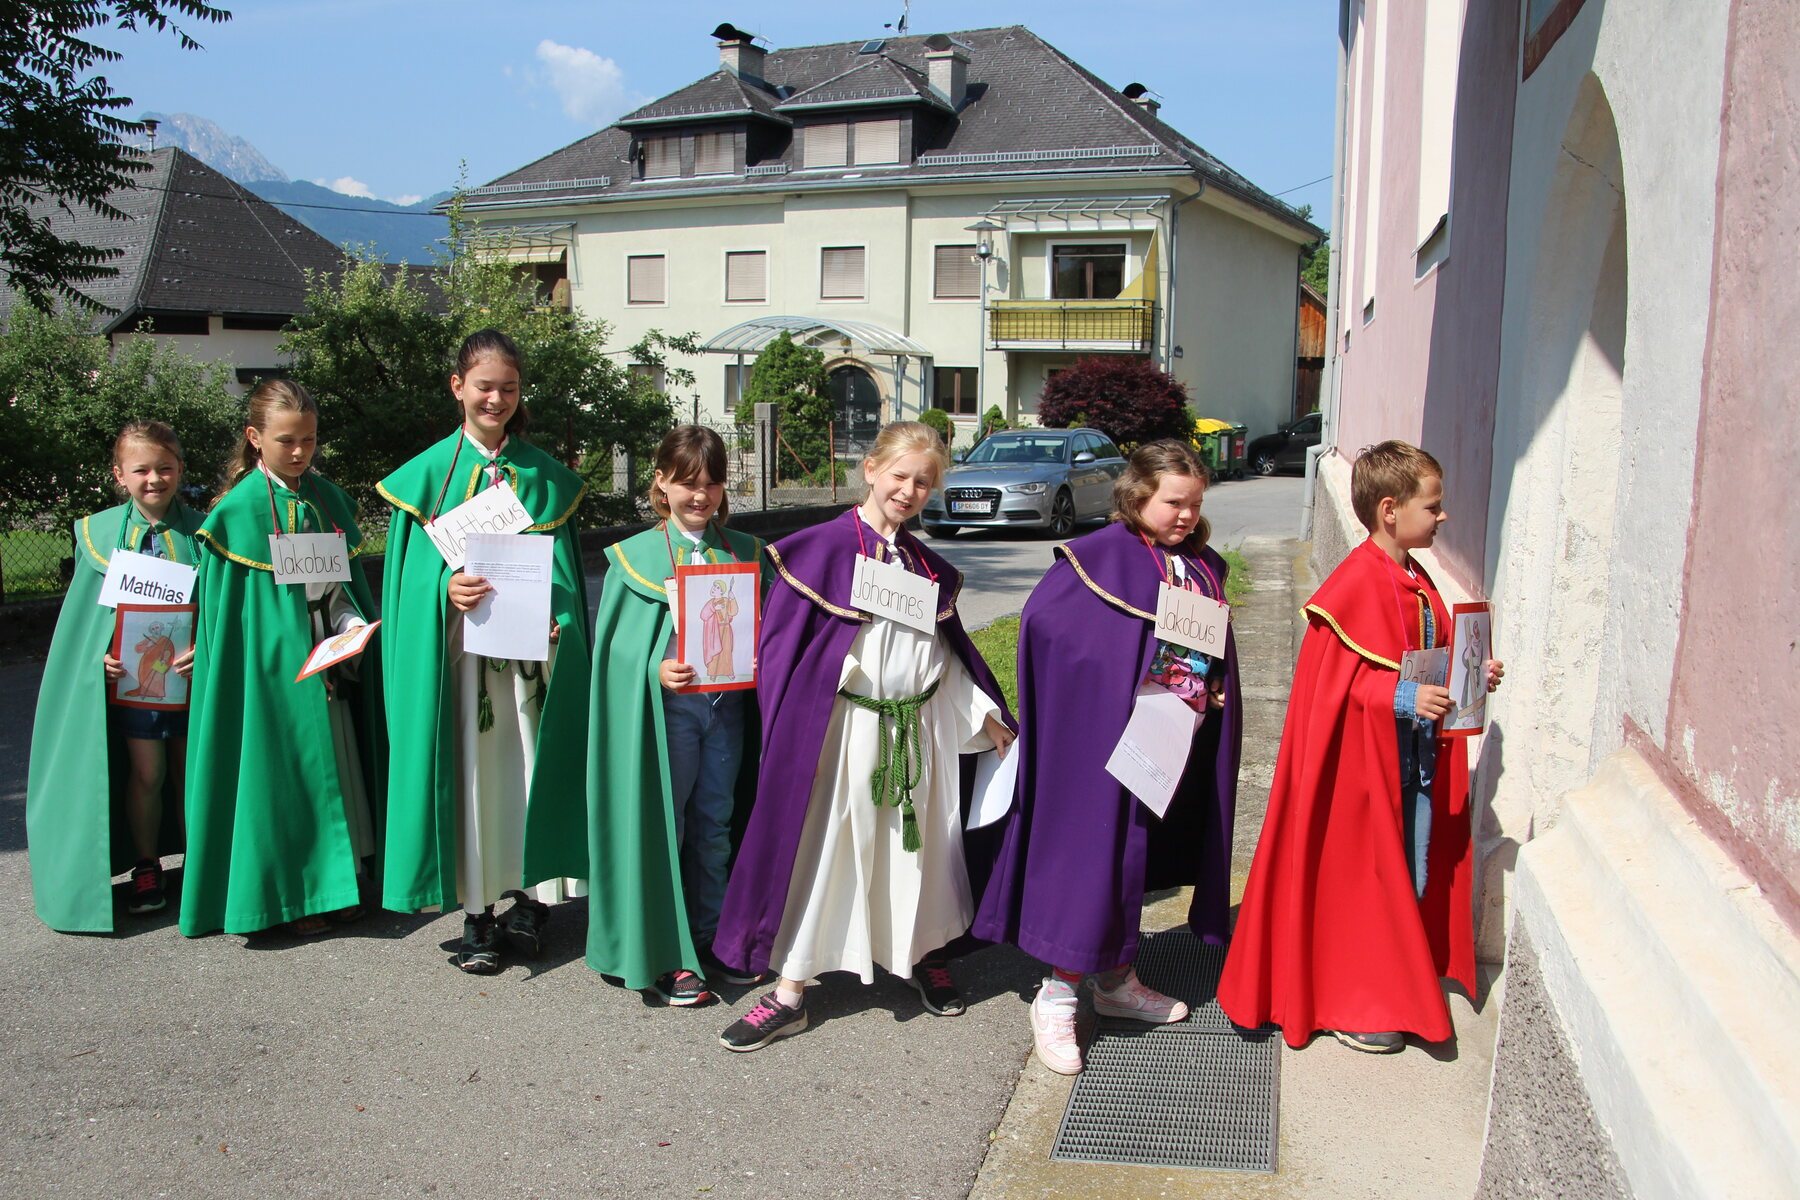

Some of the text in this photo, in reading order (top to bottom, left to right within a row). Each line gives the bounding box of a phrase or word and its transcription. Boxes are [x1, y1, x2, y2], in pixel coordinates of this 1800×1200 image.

[276, 543, 342, 577] Jakobus
[119, 574, 184, 604] Matthias
[852, 566, 924, 620] Johannes
[1157, 596, 1216, 644] Jakobus
